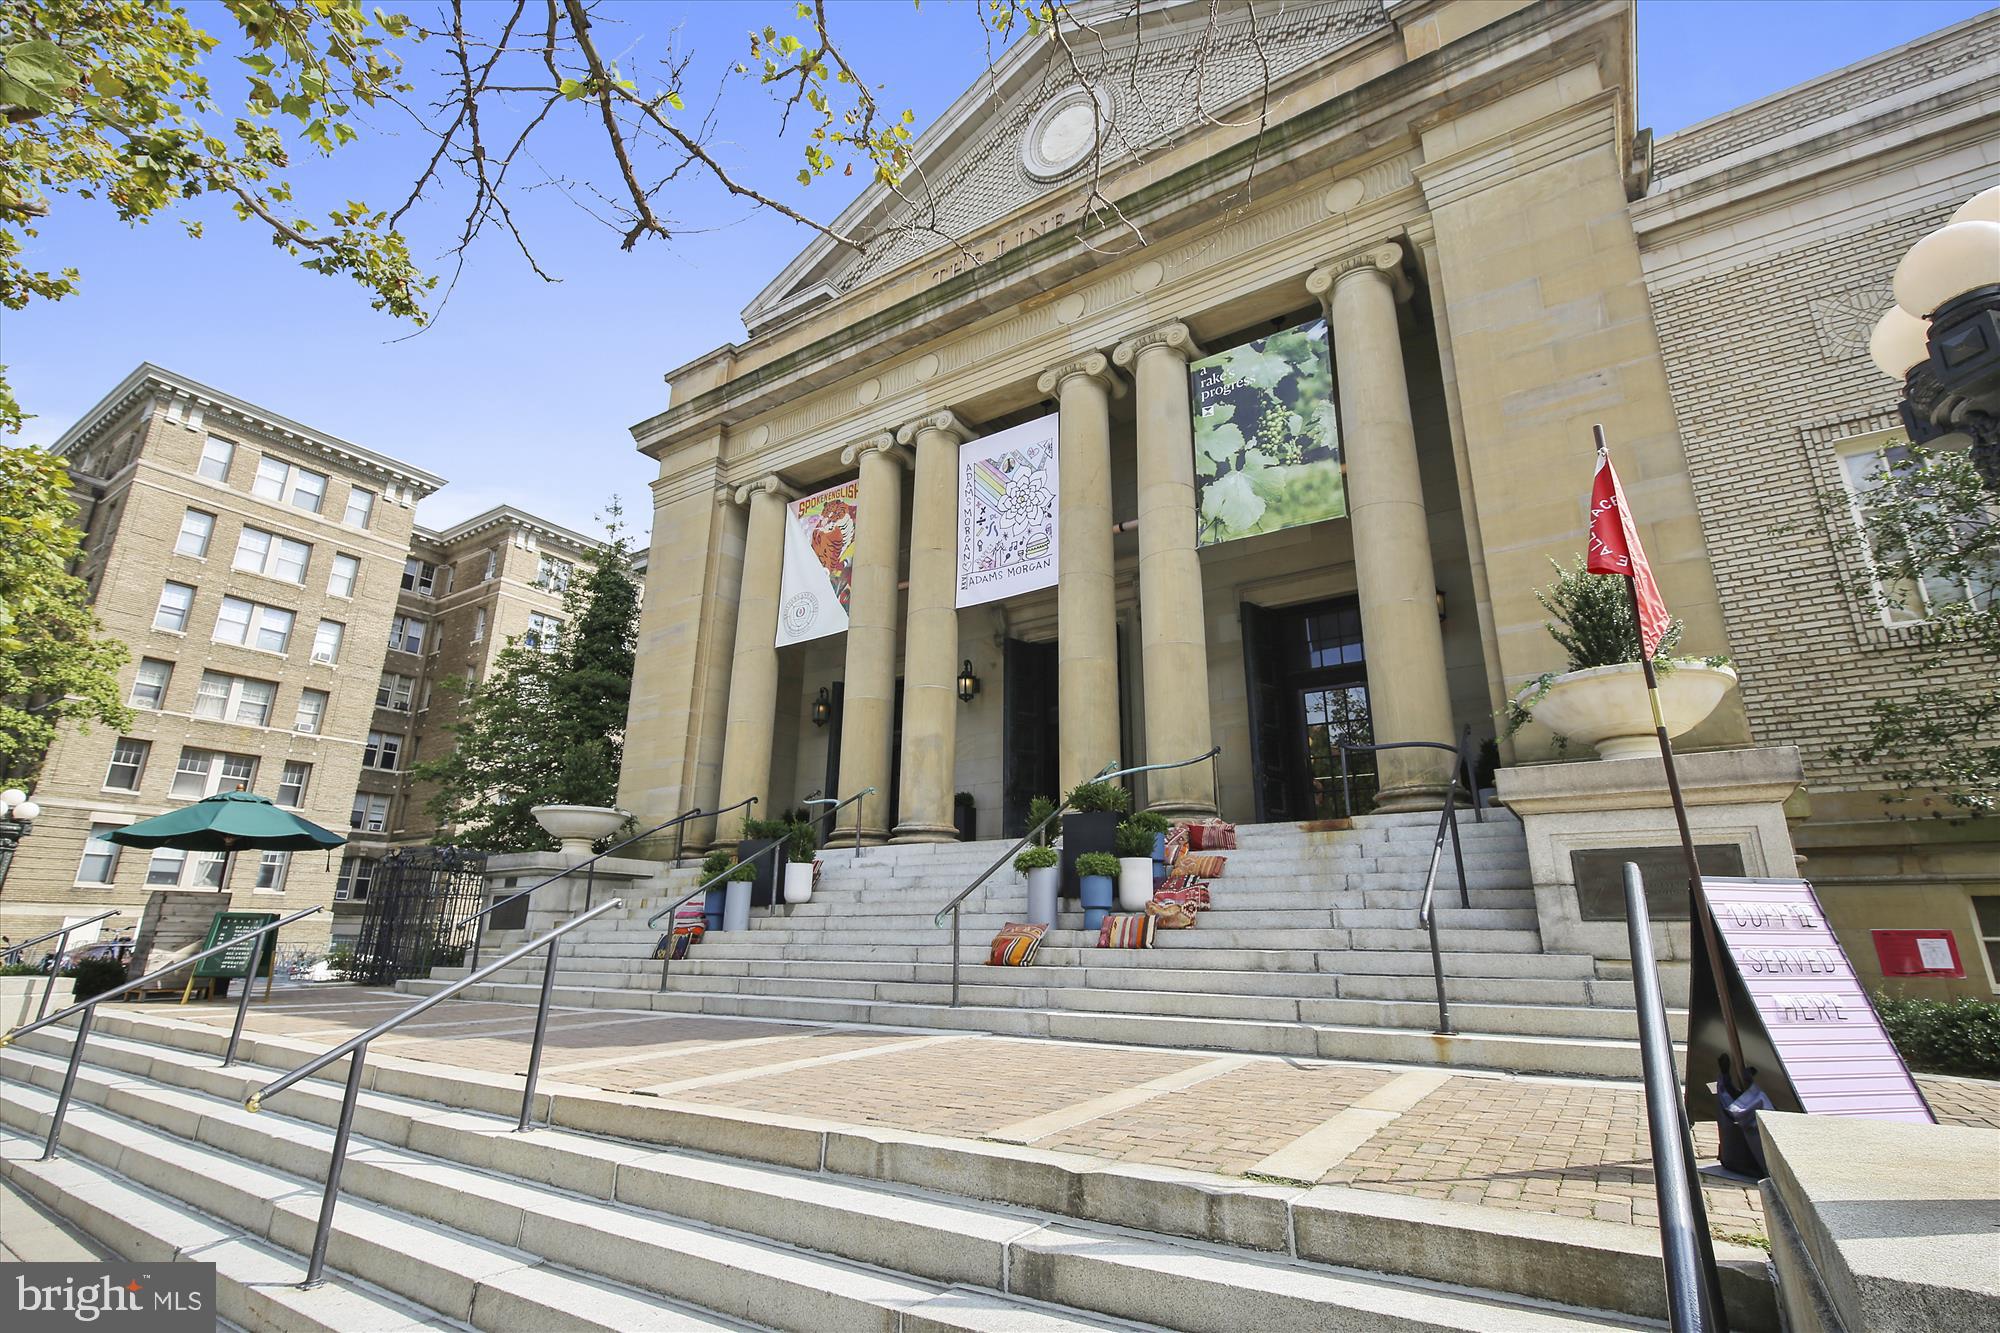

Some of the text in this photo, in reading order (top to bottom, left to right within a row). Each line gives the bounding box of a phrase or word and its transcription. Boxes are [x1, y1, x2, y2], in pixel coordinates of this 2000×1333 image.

[1200, 366, 1207, 376] a
[1201, 376, 1256, 403] progress
[963, 463, 974, 560] ADAMS MORGAN
[968, 559, 1051, 586] ADAMS MORGAN
[1745, 949, 1836, 973] SERVED
[1779, 994, 1848, 1020] HERE
